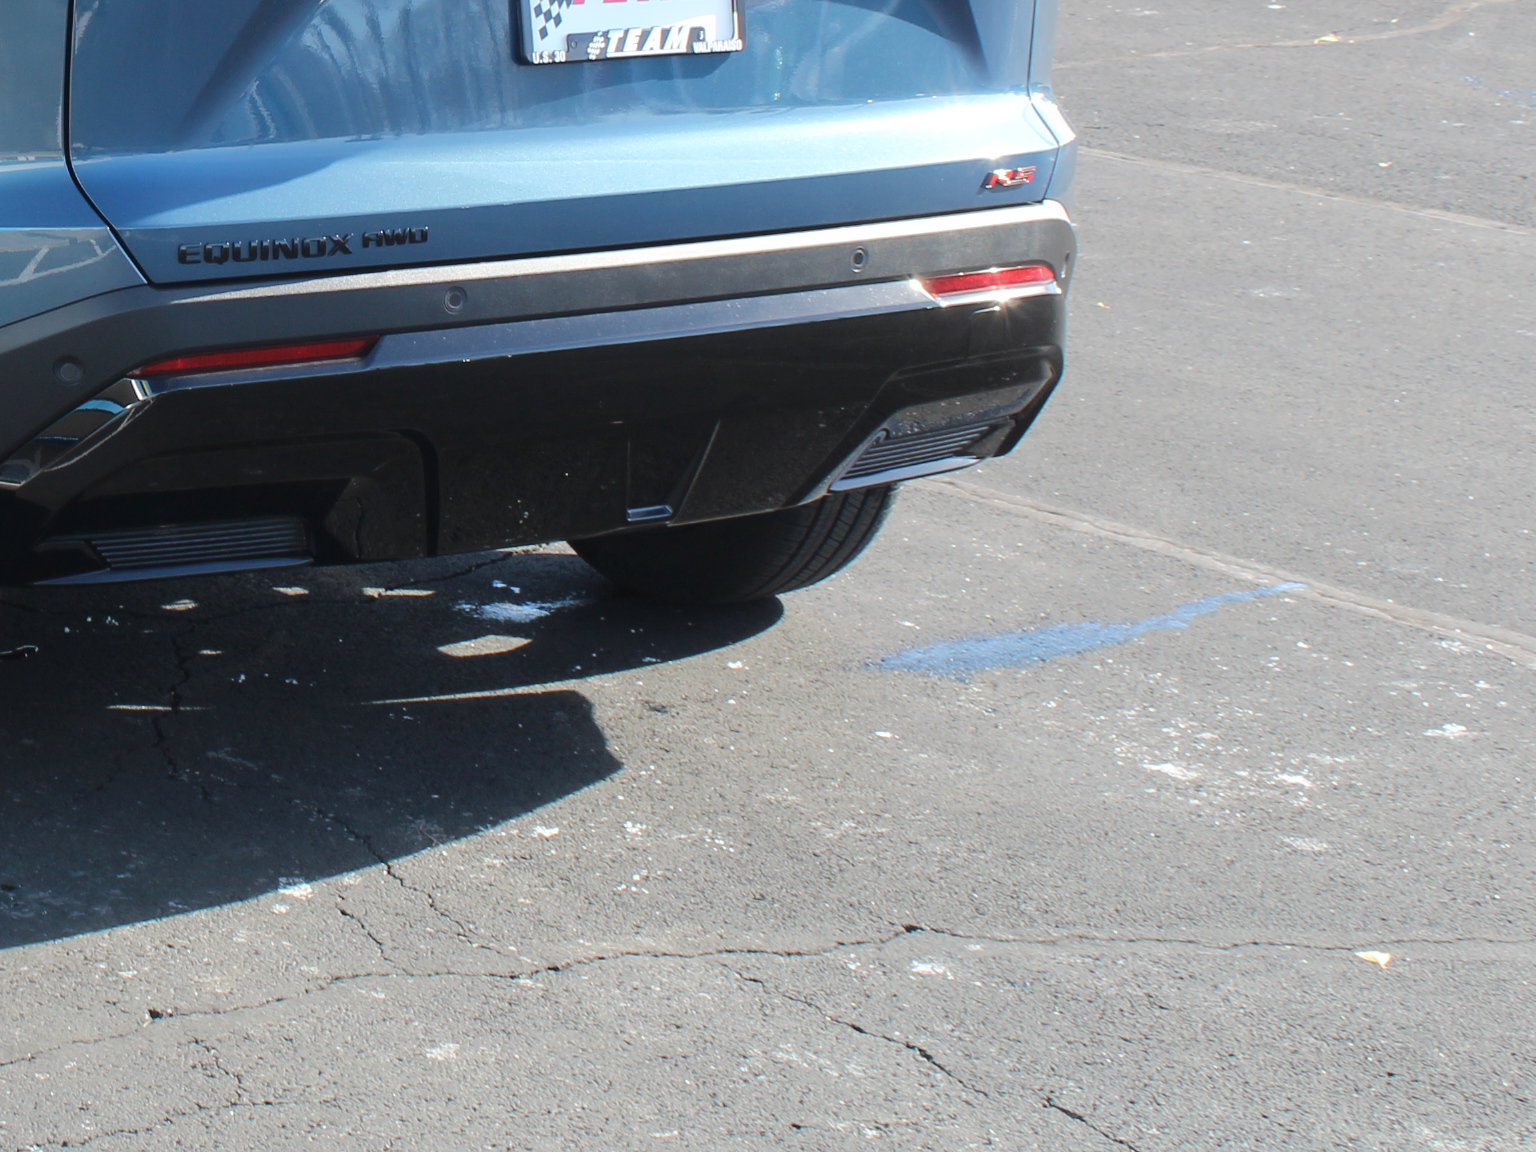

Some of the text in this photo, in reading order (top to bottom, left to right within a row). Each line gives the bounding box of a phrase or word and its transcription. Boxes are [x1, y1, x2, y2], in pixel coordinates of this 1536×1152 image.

[606, 25, 691, 54] TEAM
[532, 50, 566, 64] U.S. 30
[177, 225, 431, 266] EQUINOX AWD
